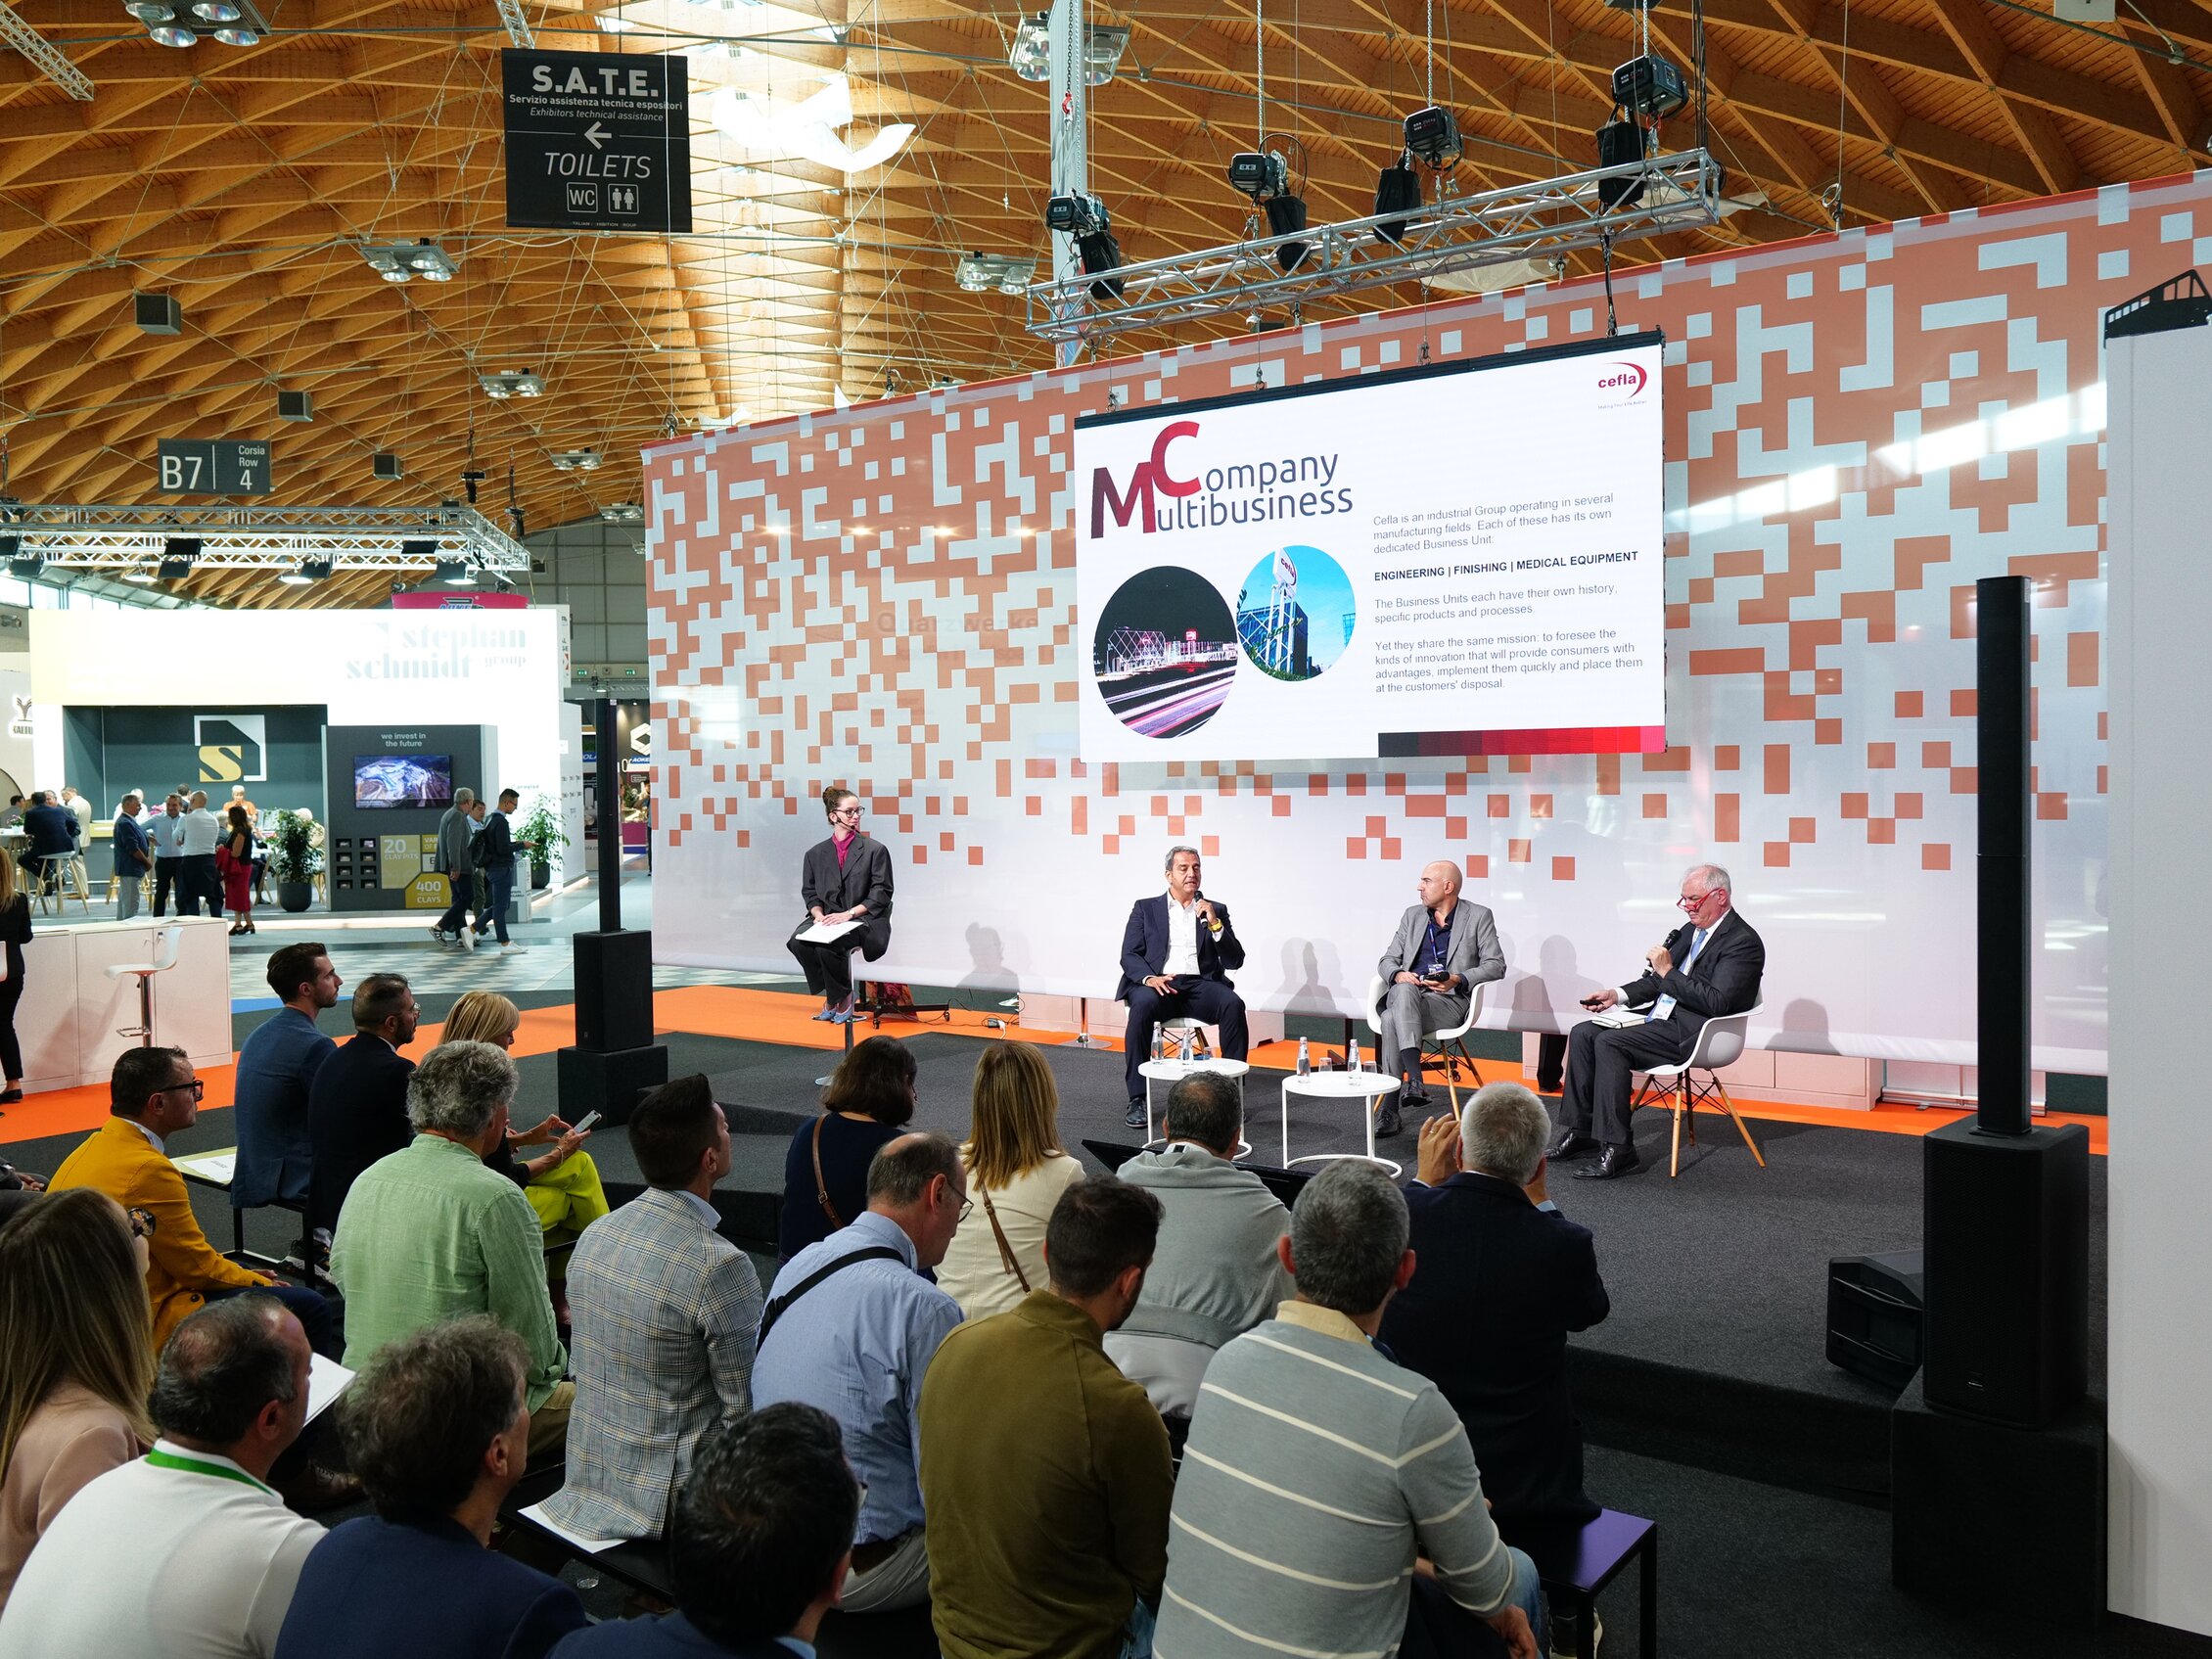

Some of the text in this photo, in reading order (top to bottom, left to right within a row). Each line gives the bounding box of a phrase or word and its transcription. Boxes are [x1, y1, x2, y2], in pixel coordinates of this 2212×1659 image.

[532, 65, 659, 97] S.A.T.E.
[509, 94, 682, 111] Servizio assistenza tecnica espositori
[530, 107, 663, 122] Exhibitors technical assistance
[545, 152, 651, 179] TOILETS
[569, 189, 595, 206] WC
[1598, 374, 1637, 388] cefla
[238, 445, 265, 455] Corsia
[1151, 420, 1338, 497] Company
[162, 456, 202, 490] B7
[239, 457, 258, 467] Row
[240, 469, 253, 490] 4
[1091, 462, 1353, 539] Multibusiness
[1373, 514, 1398, 525] Cefla
[1411, 513, 1424, 522] an
[1426, 507, 1471, 520] industrial
[1474, 505, 1507, 515] Group
[1509, 500, 1558, 513] operating
[1561, 499, 1571, 507] in
[1574, 493, 1613, 506] several
[1373, 526, 1442, 539] manufacturing
[1477, 518, 1503, 530] Each
[1505, 516, 1516, 527] of
[1519, 516, 1548, 525] these
[1551, 513, 1570, 523] has
[1573, 511, 1586, 521] its
[1588, 510, 1611, 519] own
[1373, 535, 1494, 553] dedicated Business Unit:
[1374, 567, 1445, 581] ENGINEERING
[1453, 561, 1507, 574] FINISHING
[1516, 557, 1567, 569] MEDICAL
[1570, 550, 1638, 565] EQUIPMENT
[1375, 584, 1617, 608] The Business Units each have their own history,
[1374, 612, 1411, 624] specific
[1412, 609, 1456, 622] products
[1457, 606, 1477, 617] and
[402, 622, 526, 650] stephan
[1375, 628, 1616, 651] Yet they share the same mission: to foresee the
[485, 655, 526, 668] group
[1375, 642, 1635, 664] kinds of innovation that will provide consumers with
[346, 653, 471, 679] schmidt
[1374, 657, 1643, 679] advantages, implement them quickly and place them
[1375, 683, 1384, 692] at
[1387, 682, 1402, 692] the
[1404, 680, 1458, 691] customers'
[384, 838, 406, 853] 20
[416, 881, 441, 892] 400
